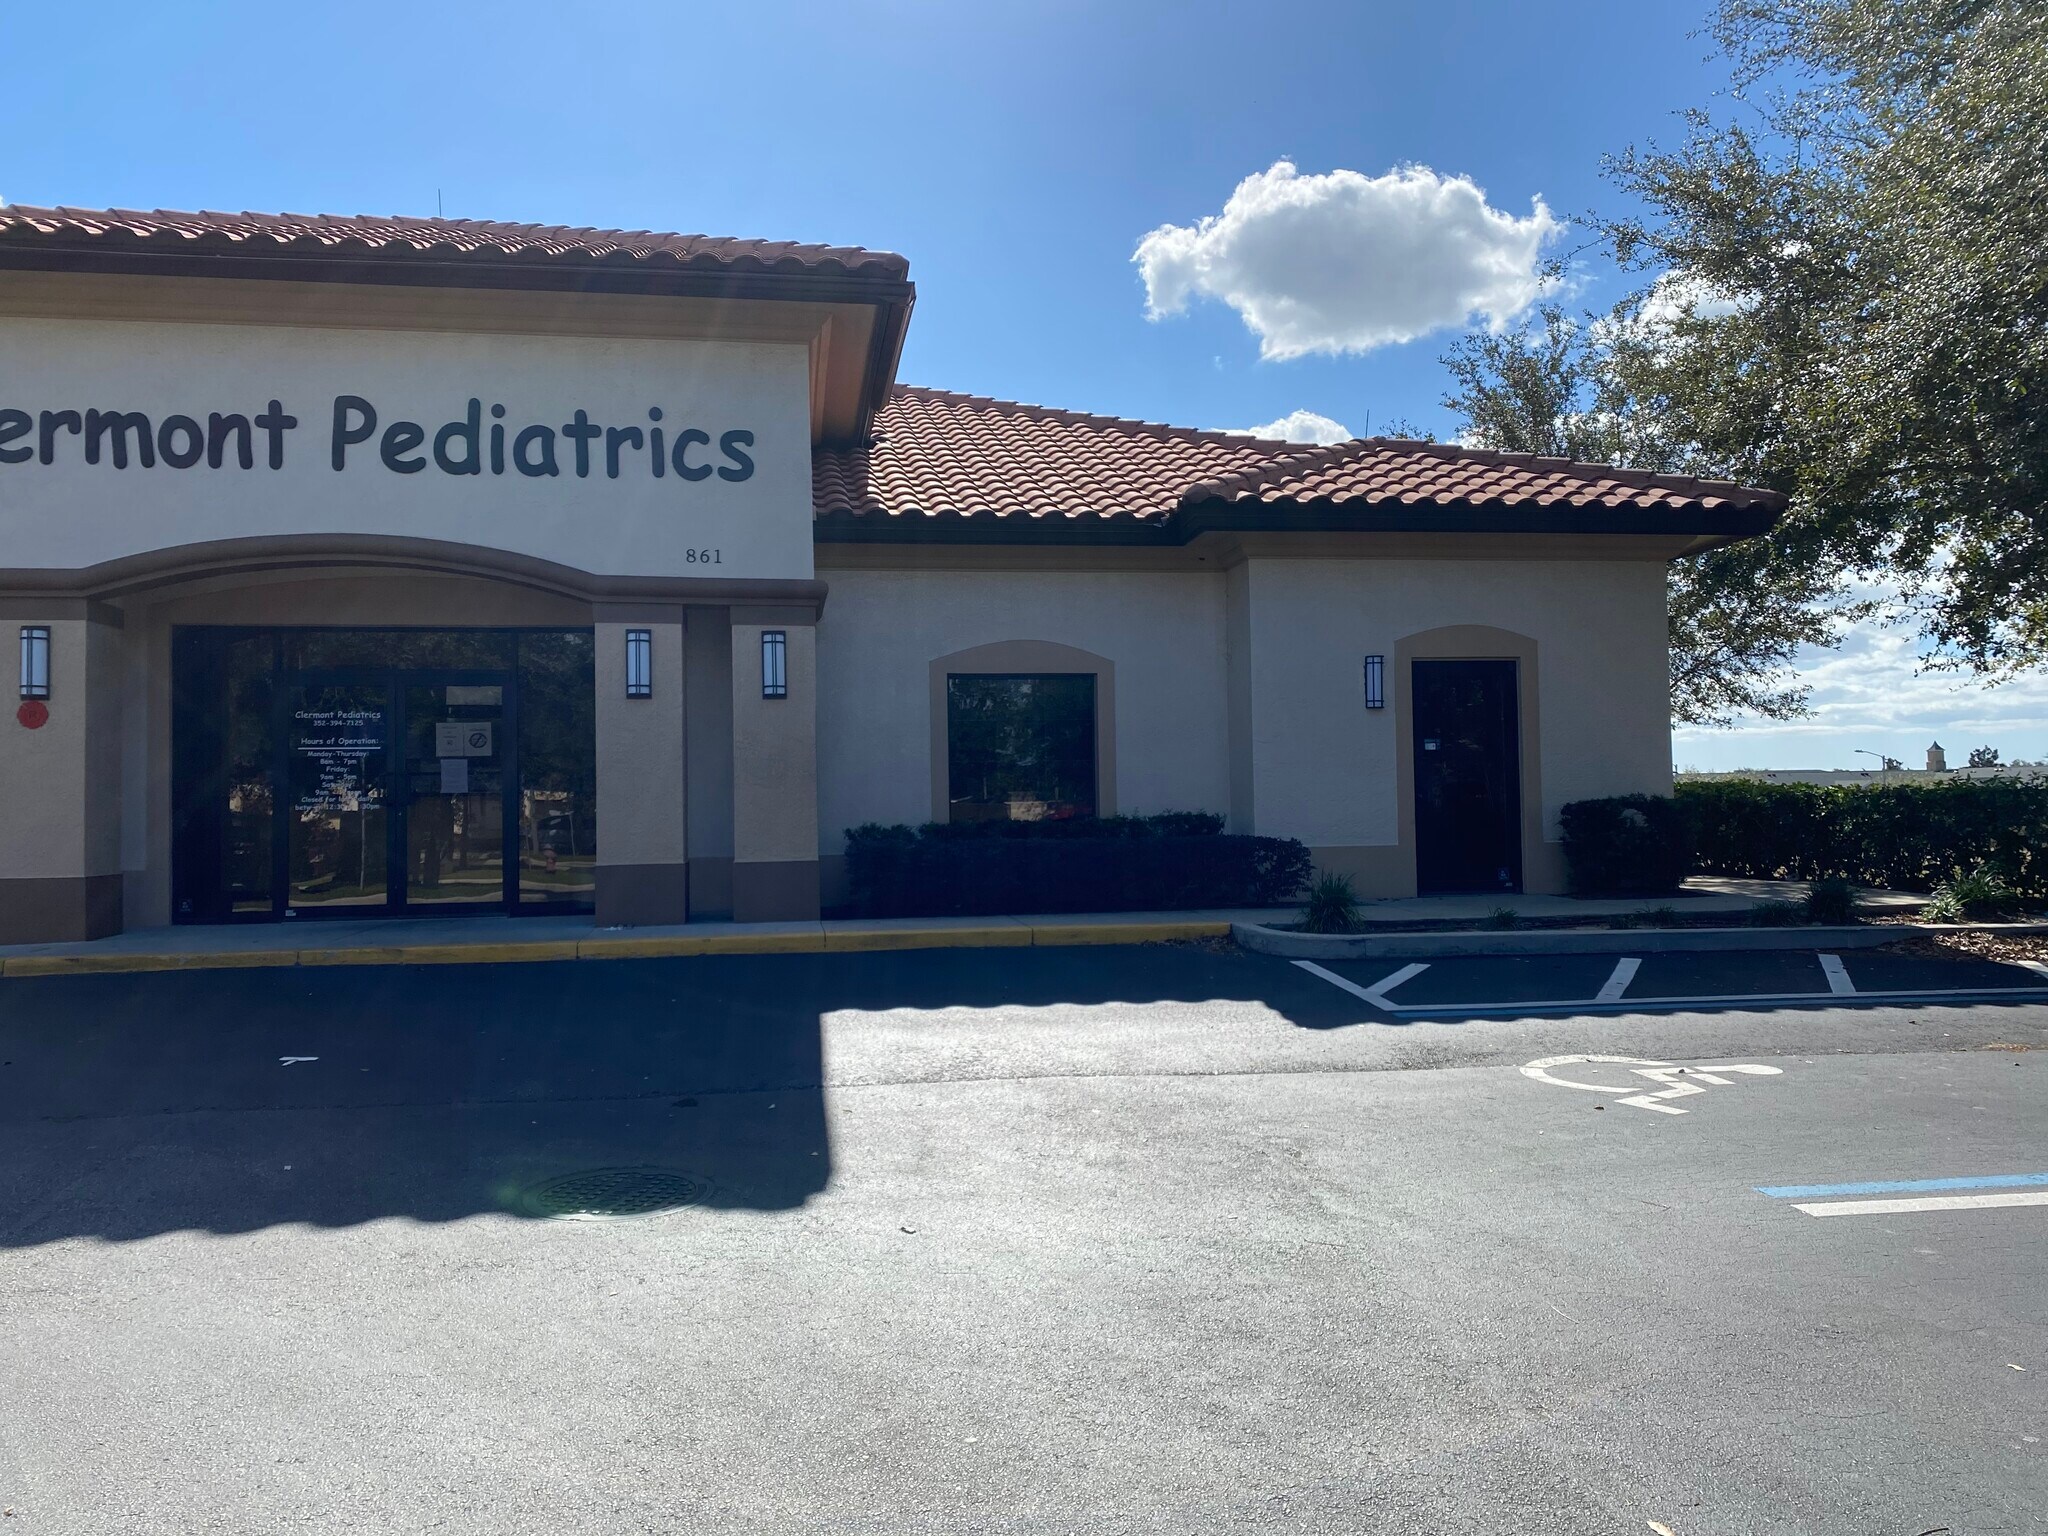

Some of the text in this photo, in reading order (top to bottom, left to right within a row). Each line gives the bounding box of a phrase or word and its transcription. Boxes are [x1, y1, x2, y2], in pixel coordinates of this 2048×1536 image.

[331, 395, 754, 482] Pediatrics
[686, 548, 722, 564] 861
[295, 711, 381, 719] Clermont Pediatrics
[337, 738, 379, 746] Operation:
